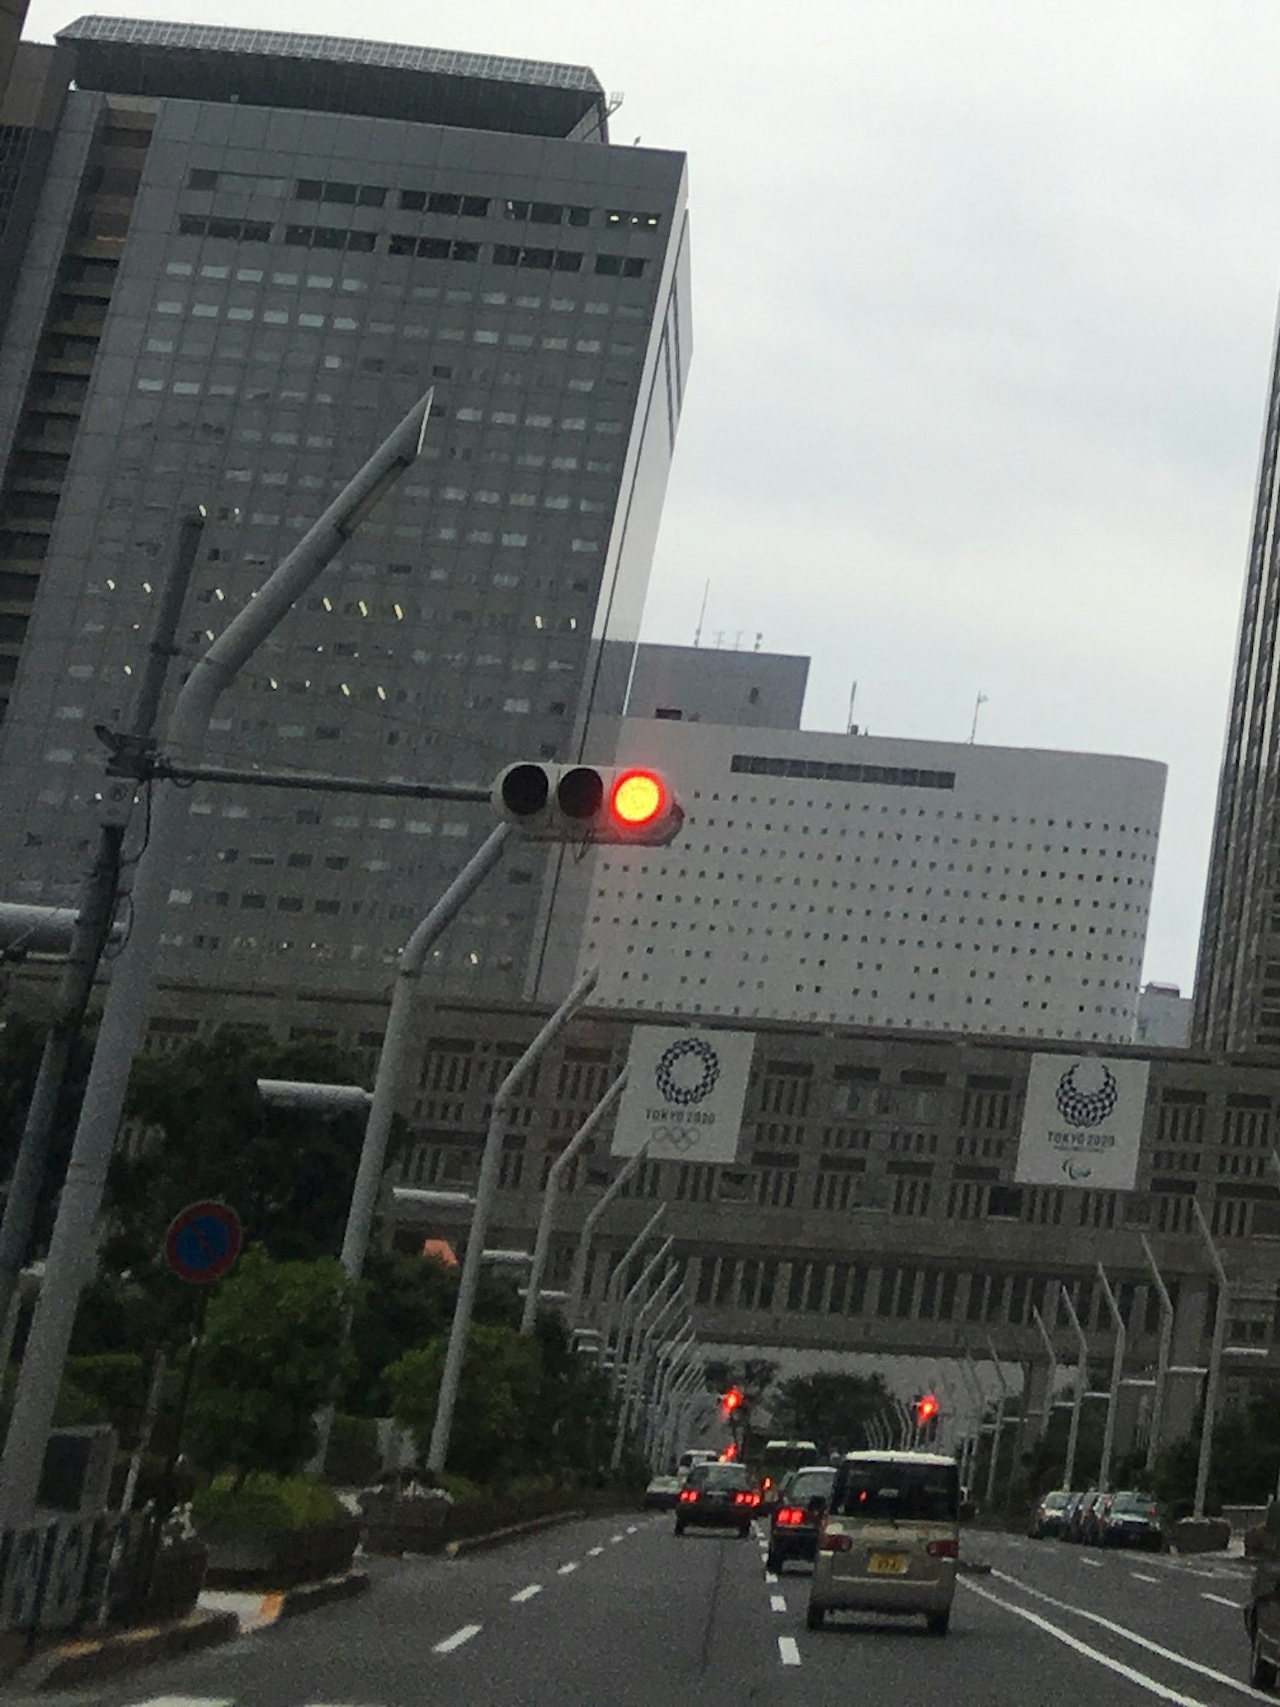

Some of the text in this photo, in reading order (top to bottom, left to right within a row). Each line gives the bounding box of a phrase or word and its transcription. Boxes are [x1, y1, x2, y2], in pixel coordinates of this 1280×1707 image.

[645, 1108, 716, 1125] TOKYO 2020
[1047, 1131, 1115, 1147] TOKYO 2020
